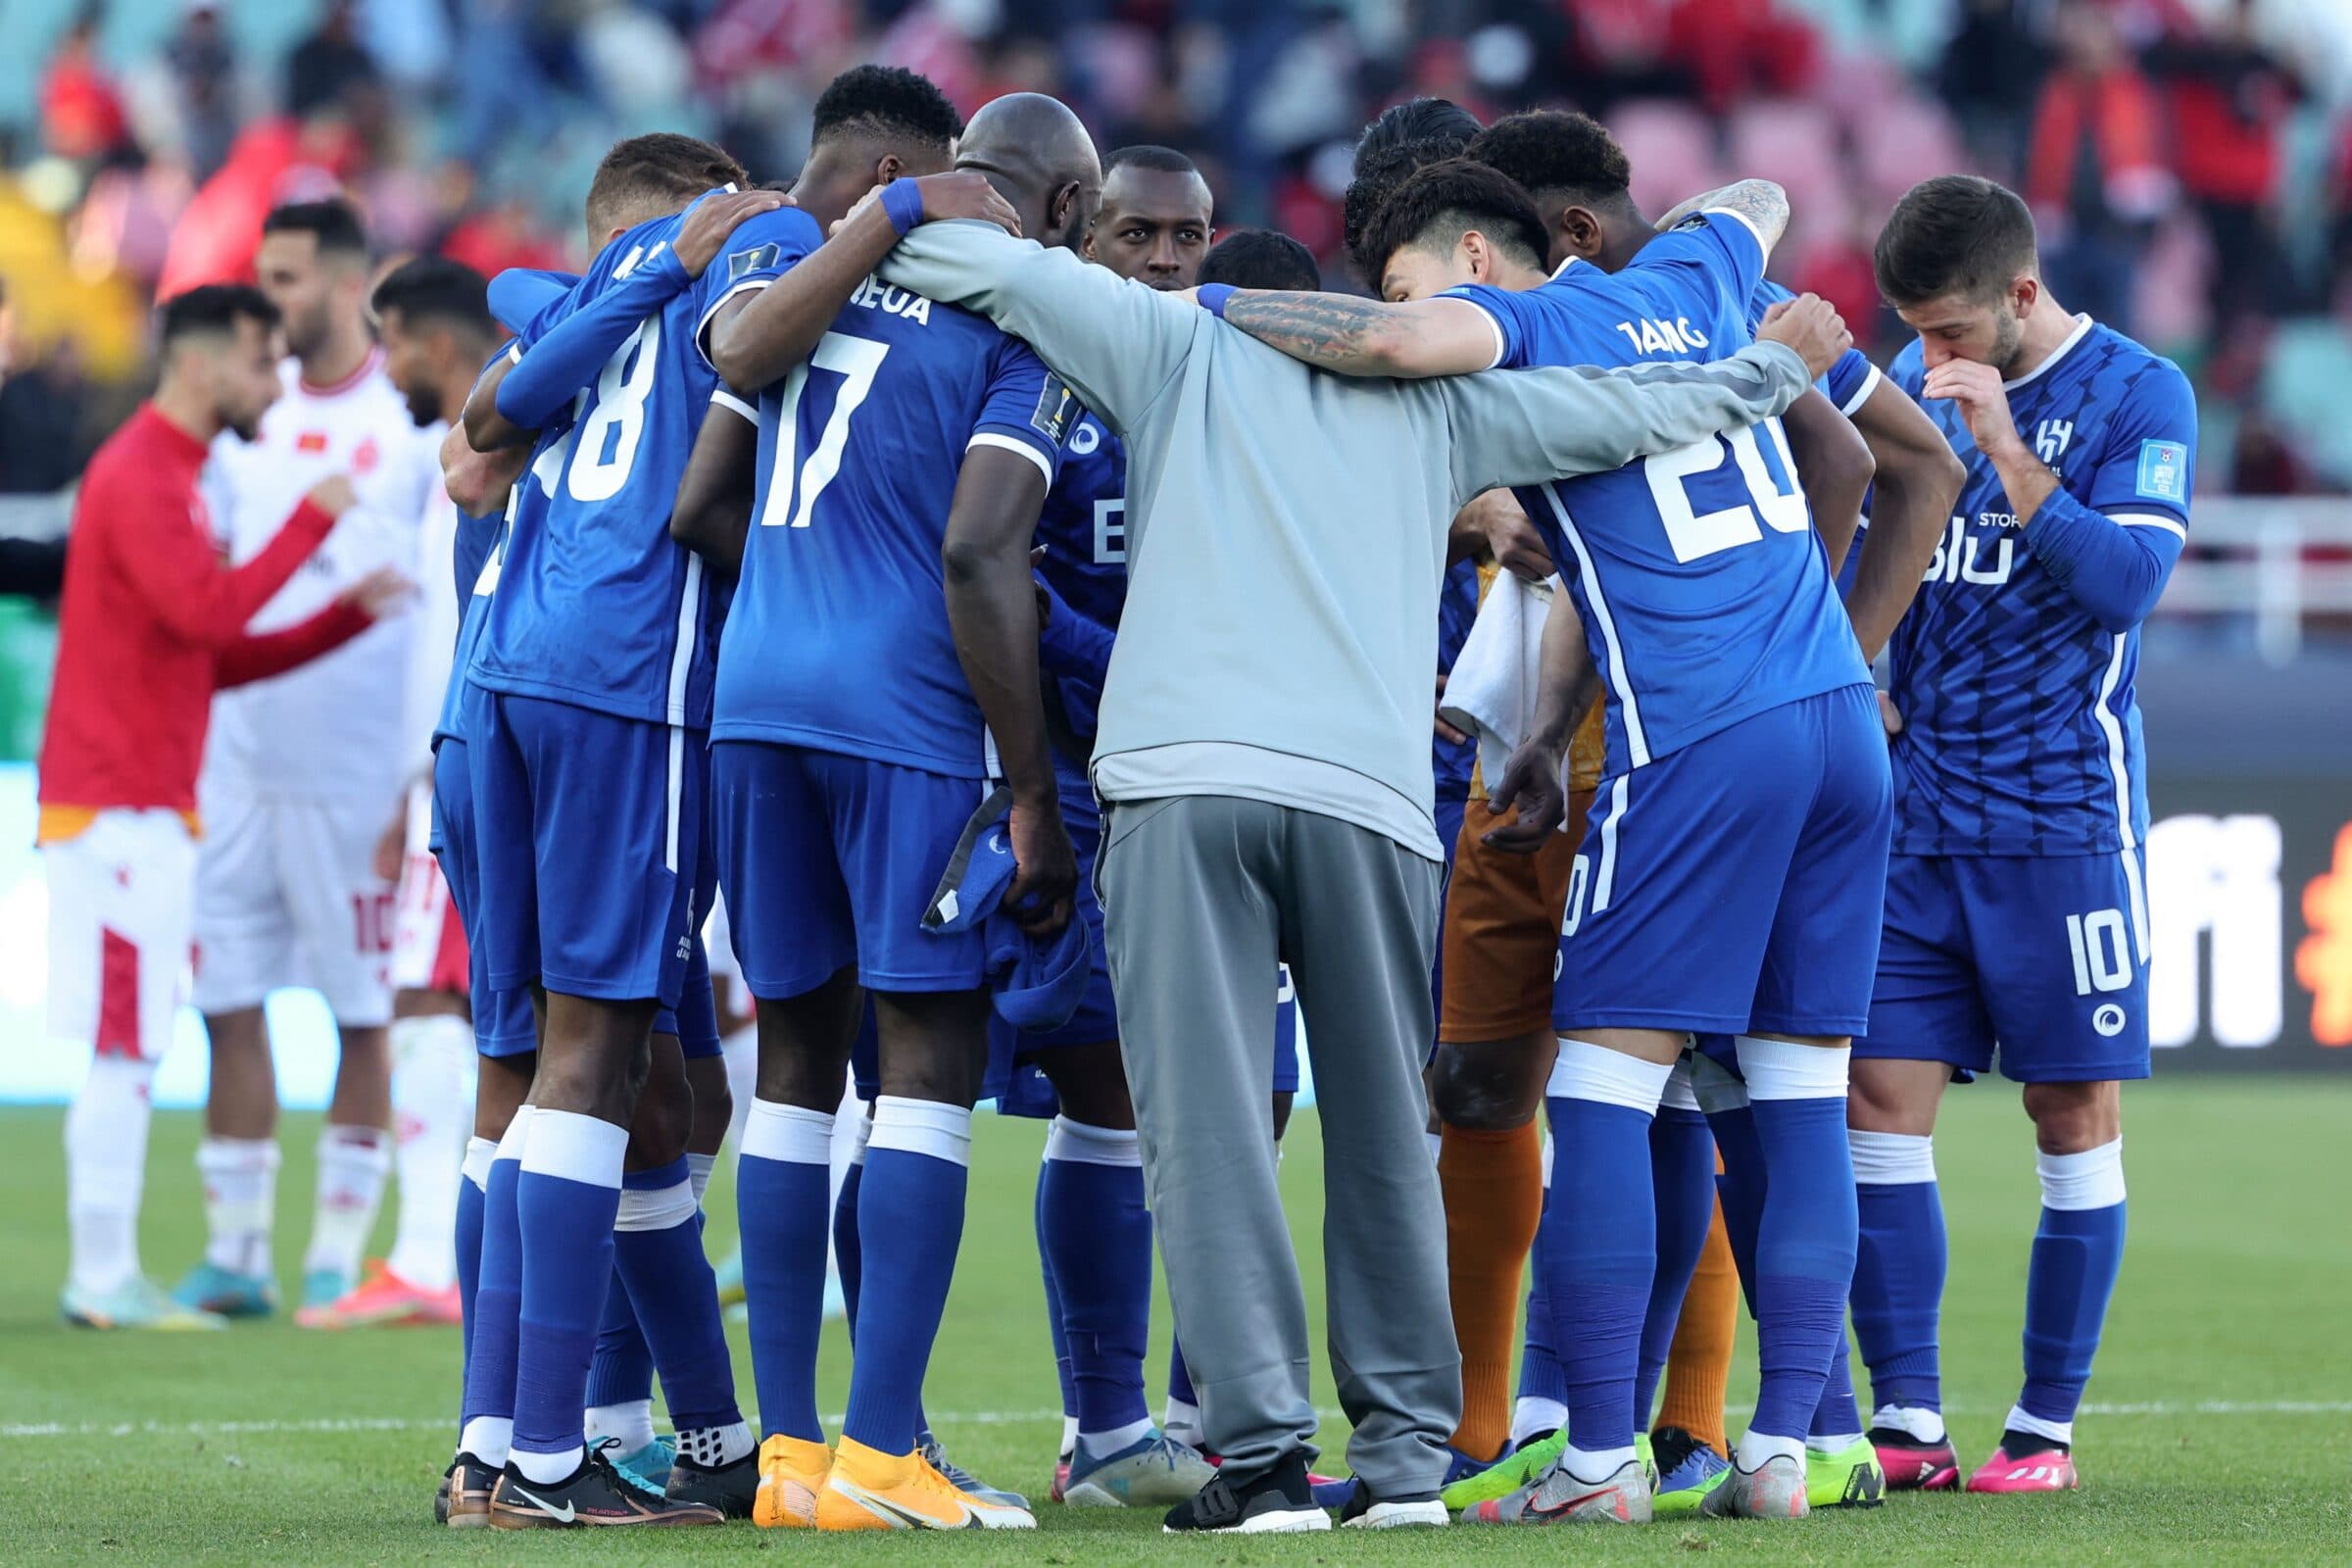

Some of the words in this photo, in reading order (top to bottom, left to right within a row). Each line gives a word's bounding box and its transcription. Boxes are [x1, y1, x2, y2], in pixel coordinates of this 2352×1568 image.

[1616, 317, 1709, 356] JANG
[760, 330, 890, 528] 17
[1644, 416, 1809, 564] 20
[2066, 907, 2132, 996] 10
